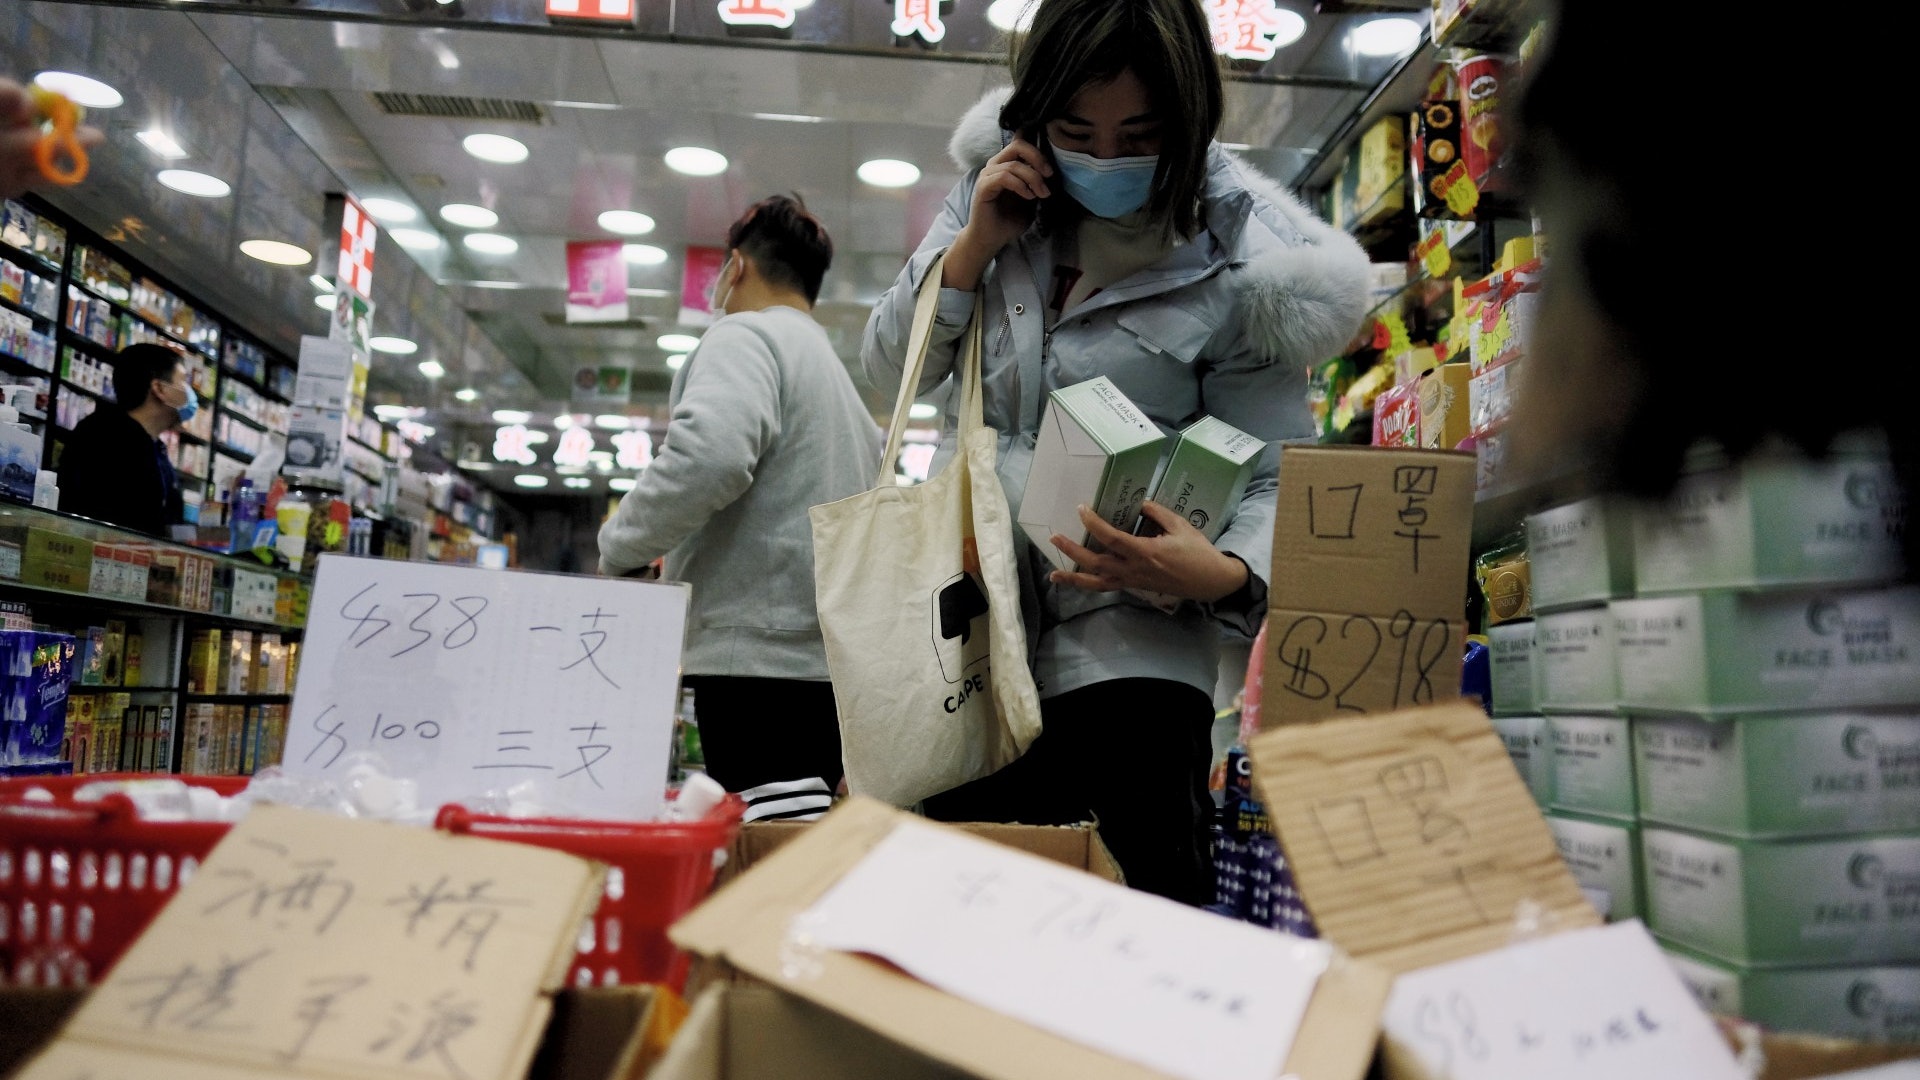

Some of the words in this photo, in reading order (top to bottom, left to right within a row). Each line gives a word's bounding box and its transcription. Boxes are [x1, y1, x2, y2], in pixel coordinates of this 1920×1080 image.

[1096, 383, 1117, 401] FACE
[1116, 403, 1140, 424] MASK
[1175, 482, 1194, 513] FACE
[1308, 465, 1443, 573] 口罩
[529, 607, 621, 689] 一支
[1278, 610, 1450, 714] $298
[943, 673, 984, 714] CAPE
[472, 720, 612, 790] 三支
